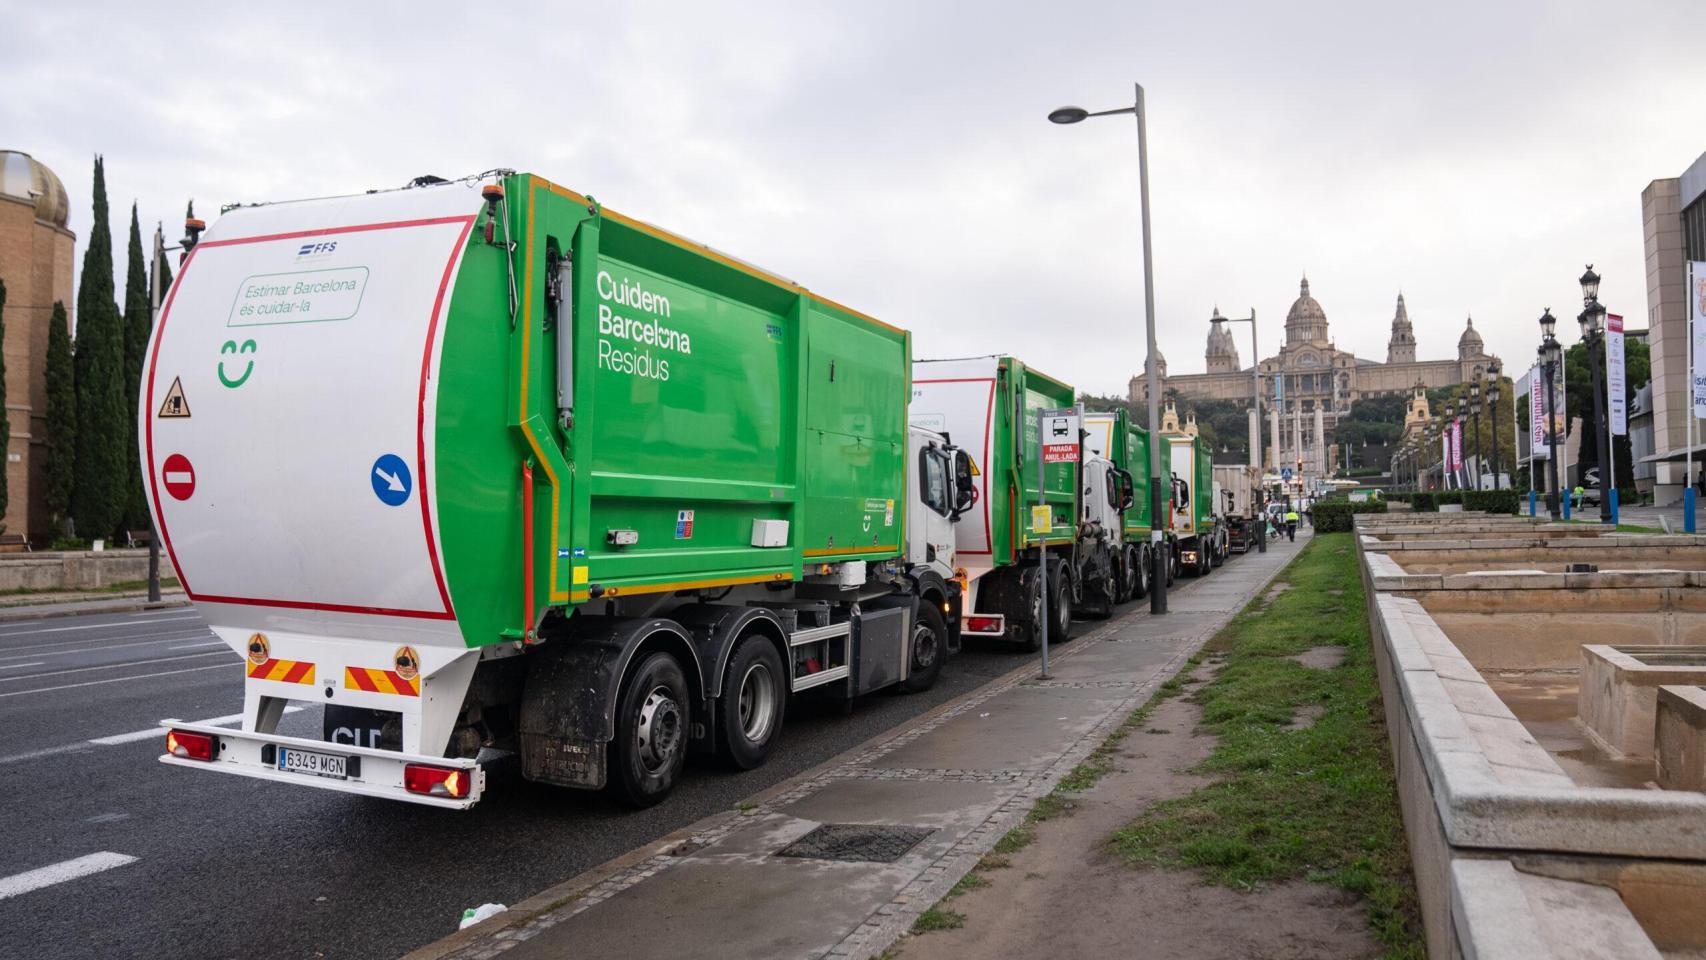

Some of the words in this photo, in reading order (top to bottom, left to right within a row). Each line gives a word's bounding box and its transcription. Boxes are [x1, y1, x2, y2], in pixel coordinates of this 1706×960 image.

[314, 241, 338, 254] FFS
[245, 284, 291, 299] Estimar
[293, 279, 357, 296] Barcelona
[597, 270, 671, 318] Cuidem
[257, 299, 312, 316] cuidar-la
[599, 303, 692, 355] Barcelona
[598, 338, 670, 382] Residus
[1049, 445, 1073, 454] PARADA
[287, 752, 317, 770] 6349
[320, 757, 344, 774] MGN
